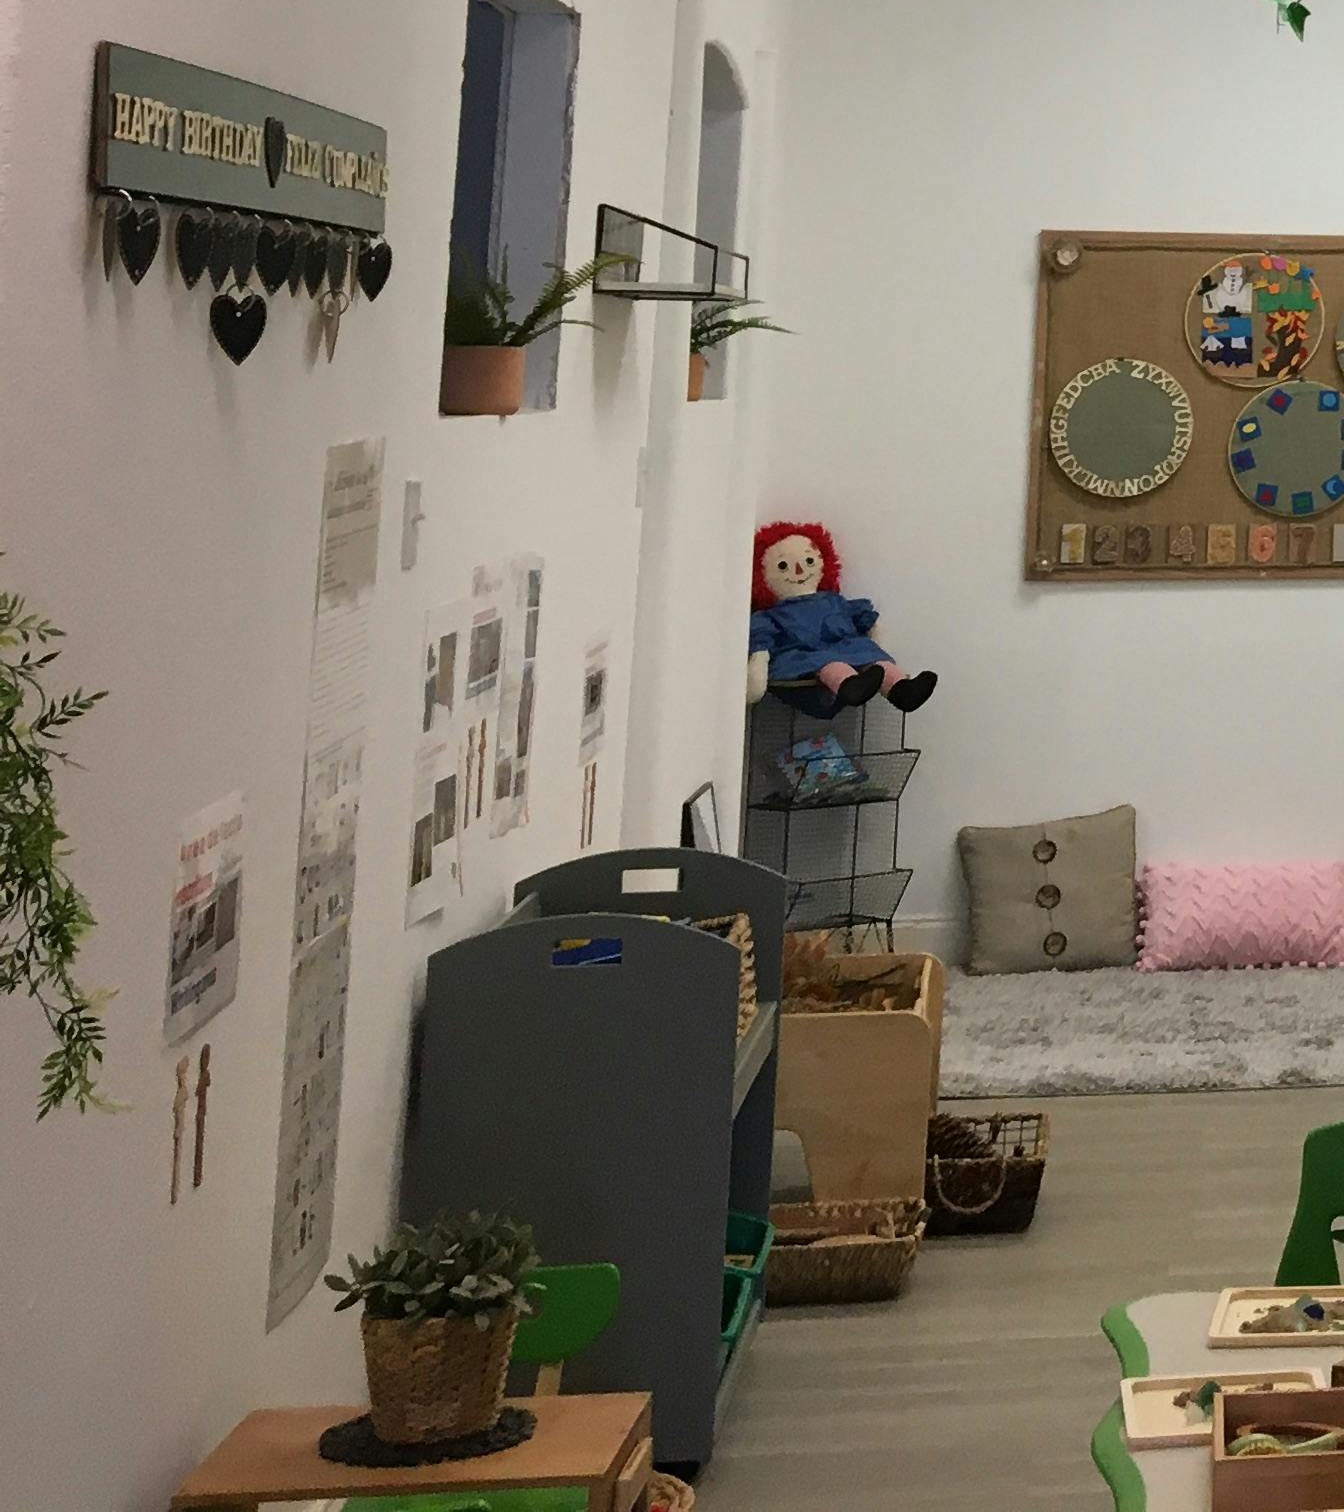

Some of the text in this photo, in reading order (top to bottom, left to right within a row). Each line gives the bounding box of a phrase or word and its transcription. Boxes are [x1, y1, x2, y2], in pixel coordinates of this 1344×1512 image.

[114, 92, 178, 152] HAPPY
[181, 109, 265, 168] BIRTHDAY
[285, 133, 321, 179] FELIZ
[1094, 525, 1120, 563] 2
[1169, 525, 1196, 563] 4
[1249, 524, 1277, 563] 6
[1290, 524, 1316, 563] 7
